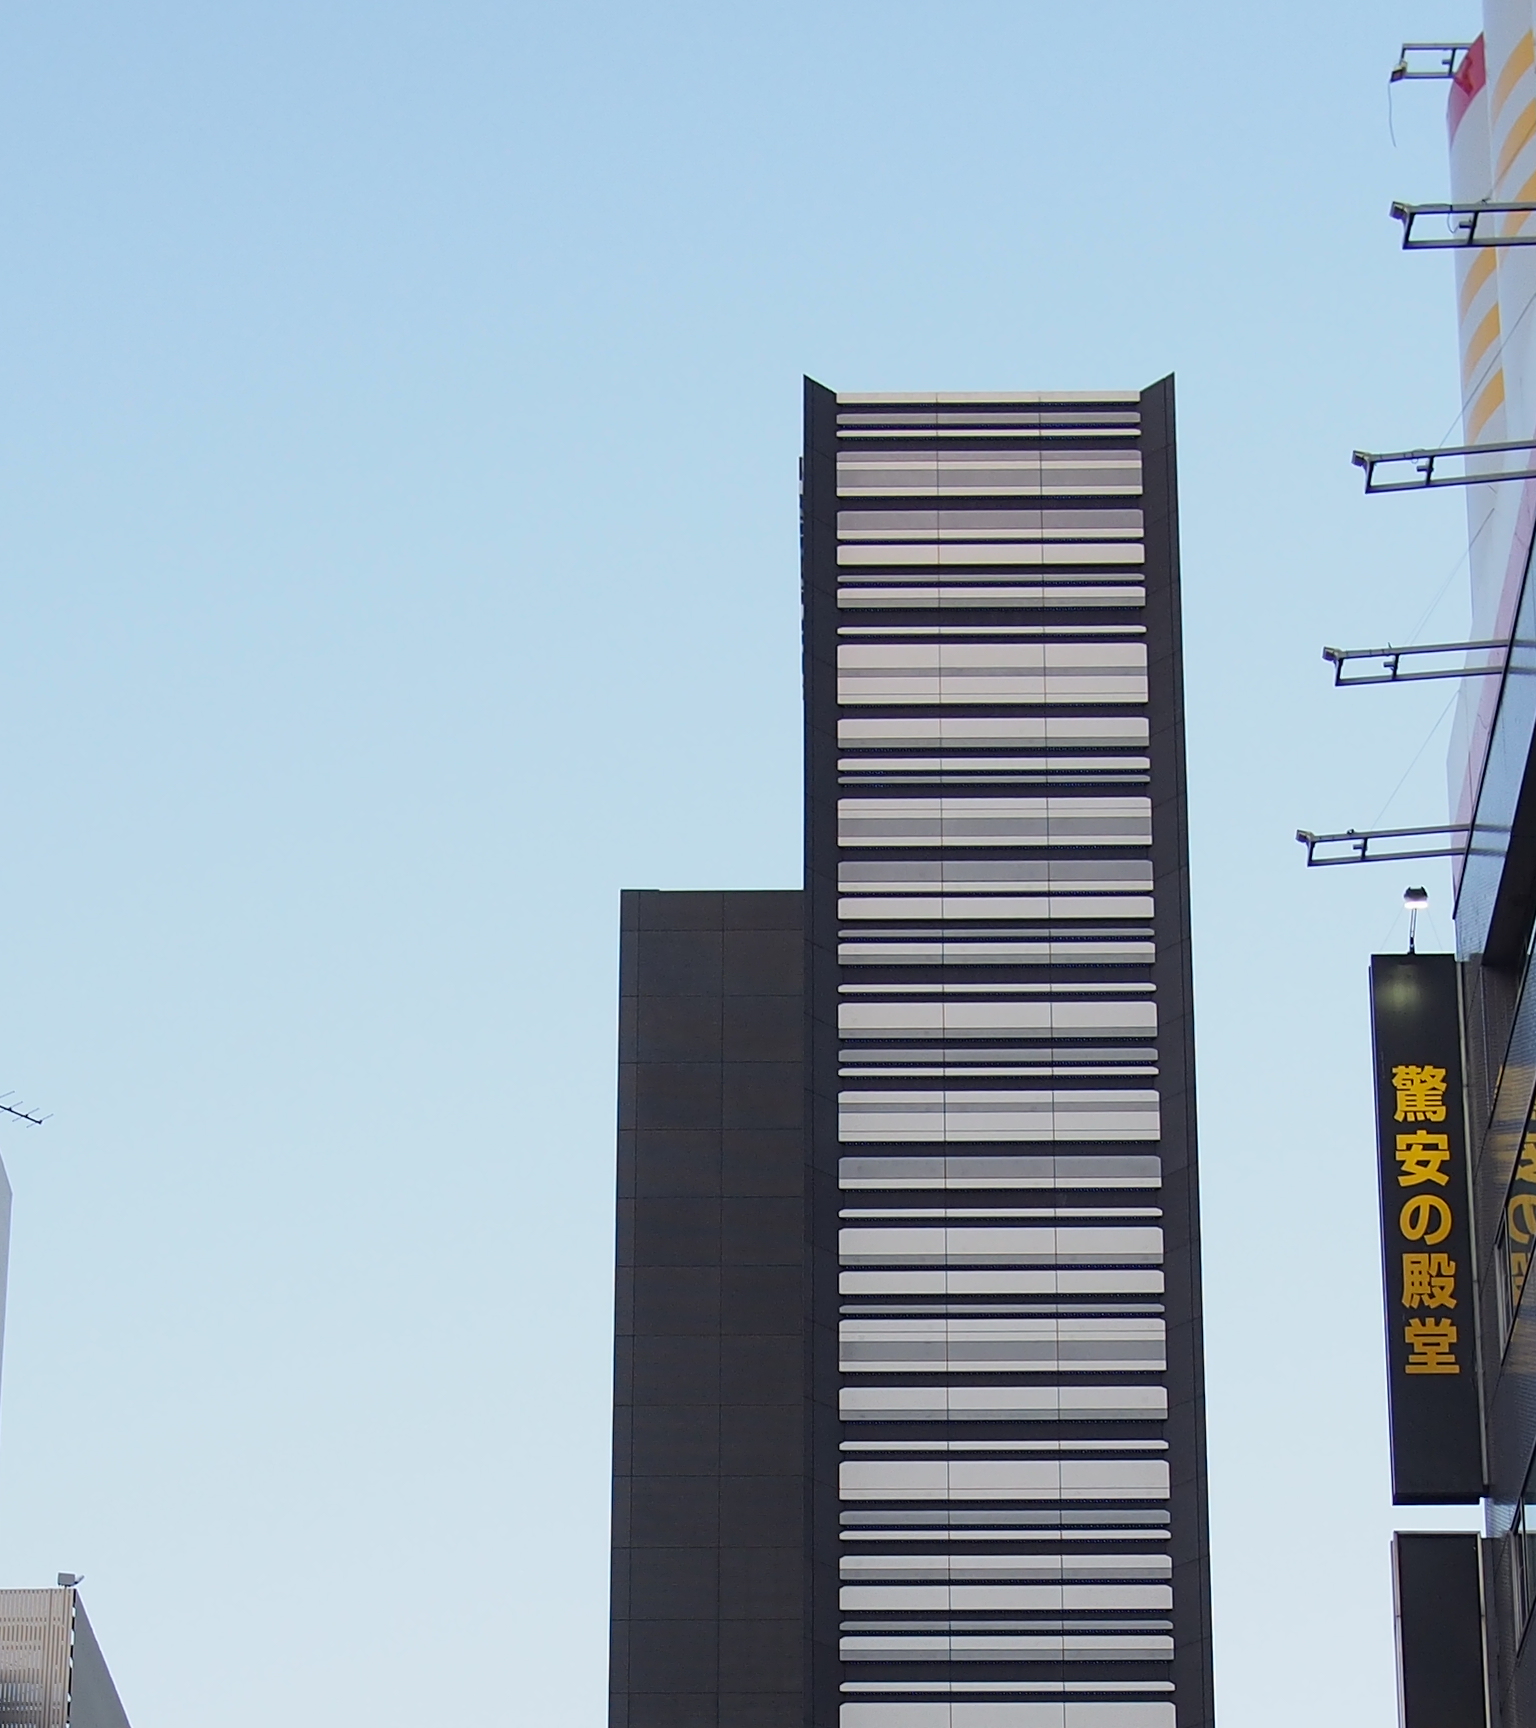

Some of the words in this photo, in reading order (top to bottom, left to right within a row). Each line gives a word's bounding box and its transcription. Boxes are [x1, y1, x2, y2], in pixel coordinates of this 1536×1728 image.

[1391, 1064, 1462, 1375] 驚安の殿堂
